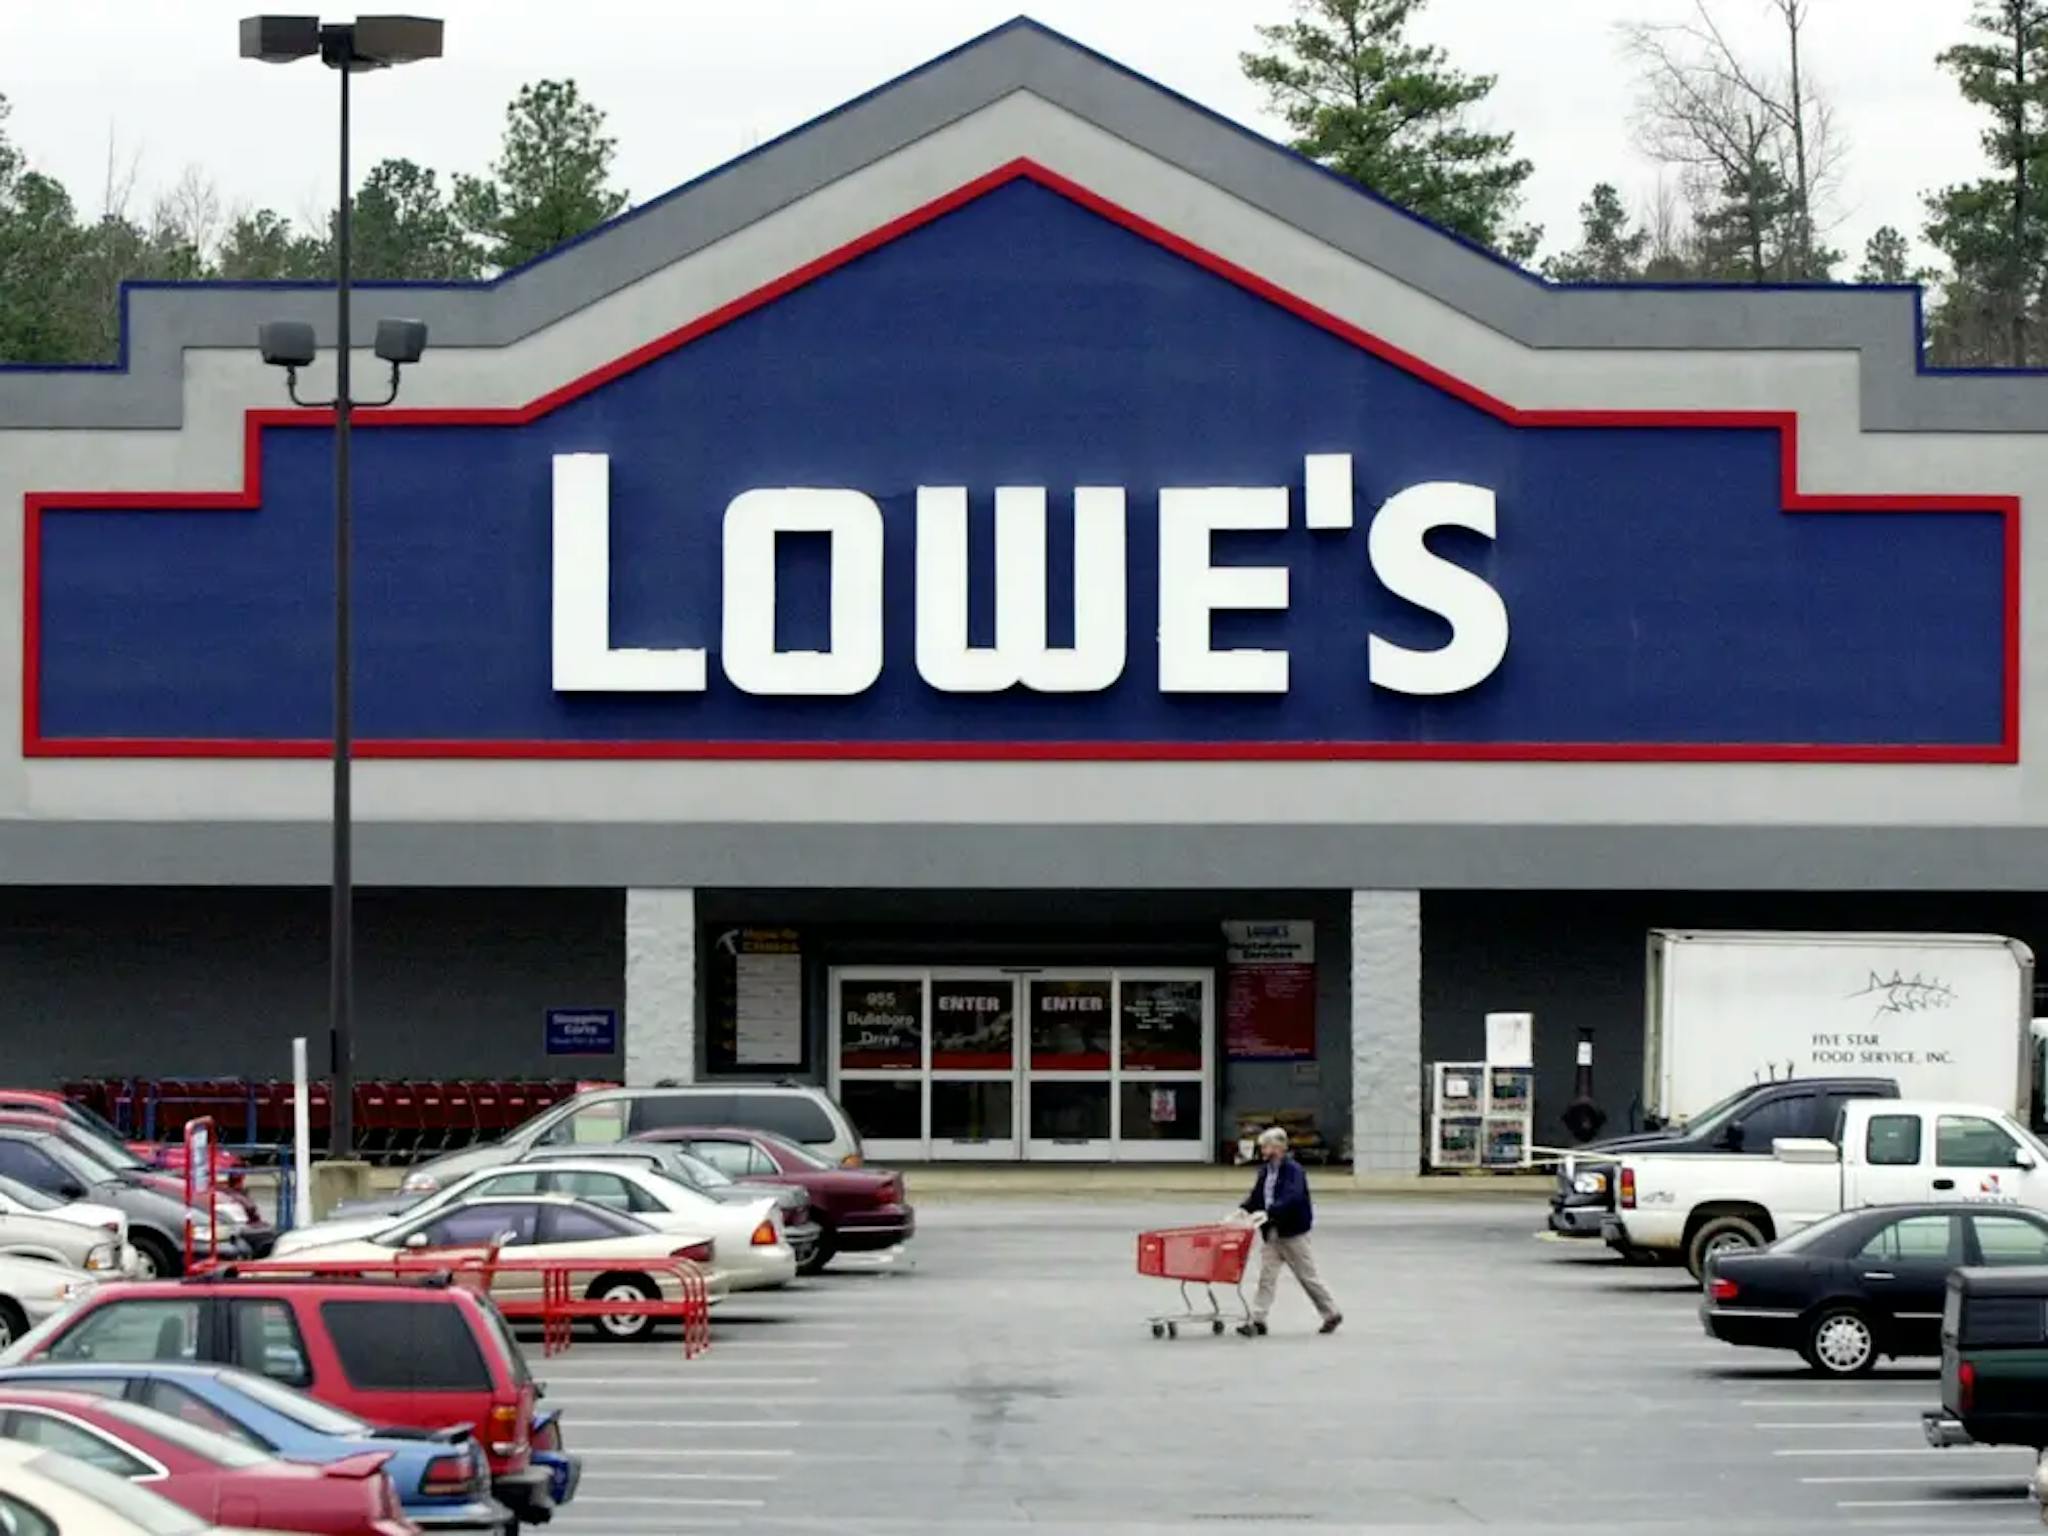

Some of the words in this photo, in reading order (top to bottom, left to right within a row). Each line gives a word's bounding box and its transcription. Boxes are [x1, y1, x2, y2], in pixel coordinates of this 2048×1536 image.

[553, 453, 1509, 695] LOWE'S
[938, 996, 1000, 1011] ENTER
[1041, 996, 1103, 1011] ENTER
[861, 1031, 900, 1046] Drive
[1812, 1034, 1839, 1046] FIVE
[1847, 1034, 1879, 1046] STAR
[1812, 1051, 1855, 1064] FOOD
[1861, 1051, 1921, 1064] SERVICE,
[1926, 1051, 1954, 1064] INC.
